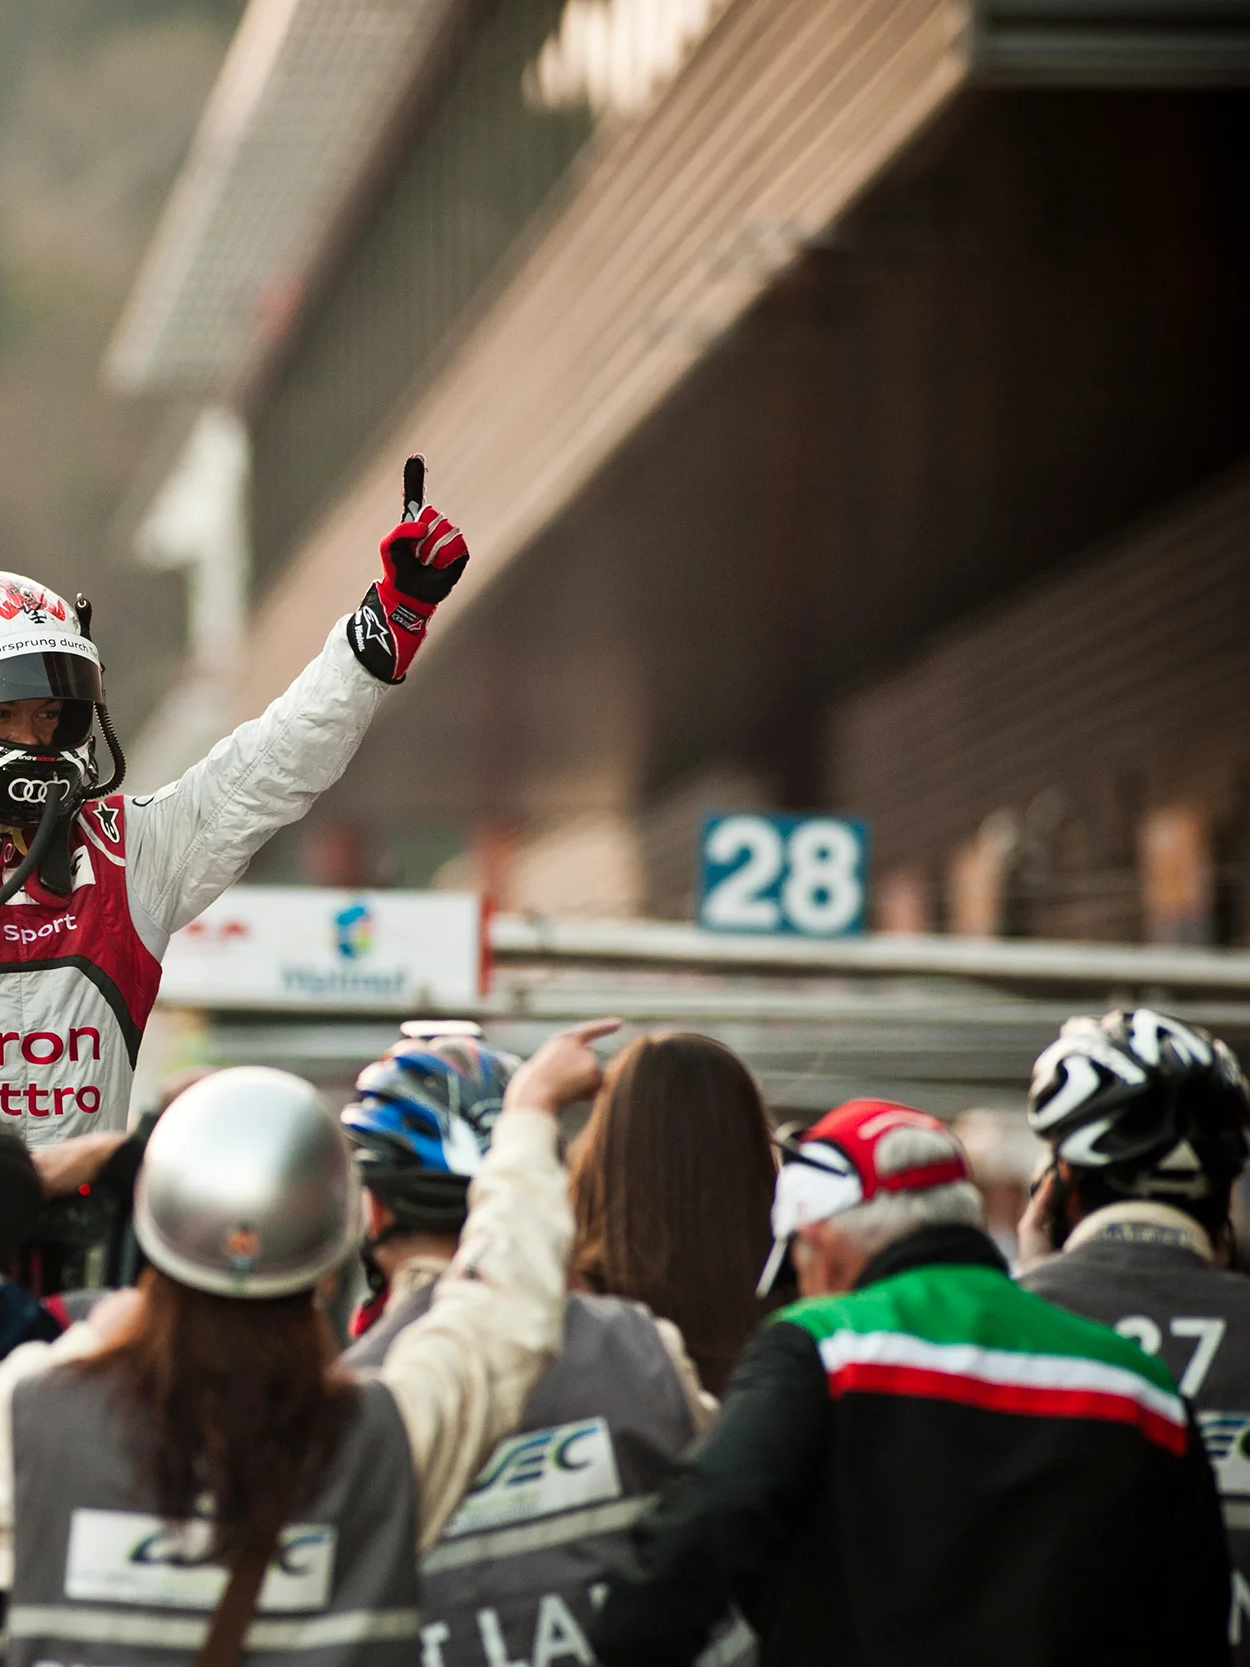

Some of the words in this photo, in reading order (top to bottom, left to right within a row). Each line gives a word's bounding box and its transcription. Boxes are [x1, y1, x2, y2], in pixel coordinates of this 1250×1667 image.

[60, 638, 89, 653] durch
[703, 814, 862, 933] 28
[3, 914, 78, 945] Sport
[466, 1425, 599, 1493] EC
[130, 1532, 326, 1576] WC
